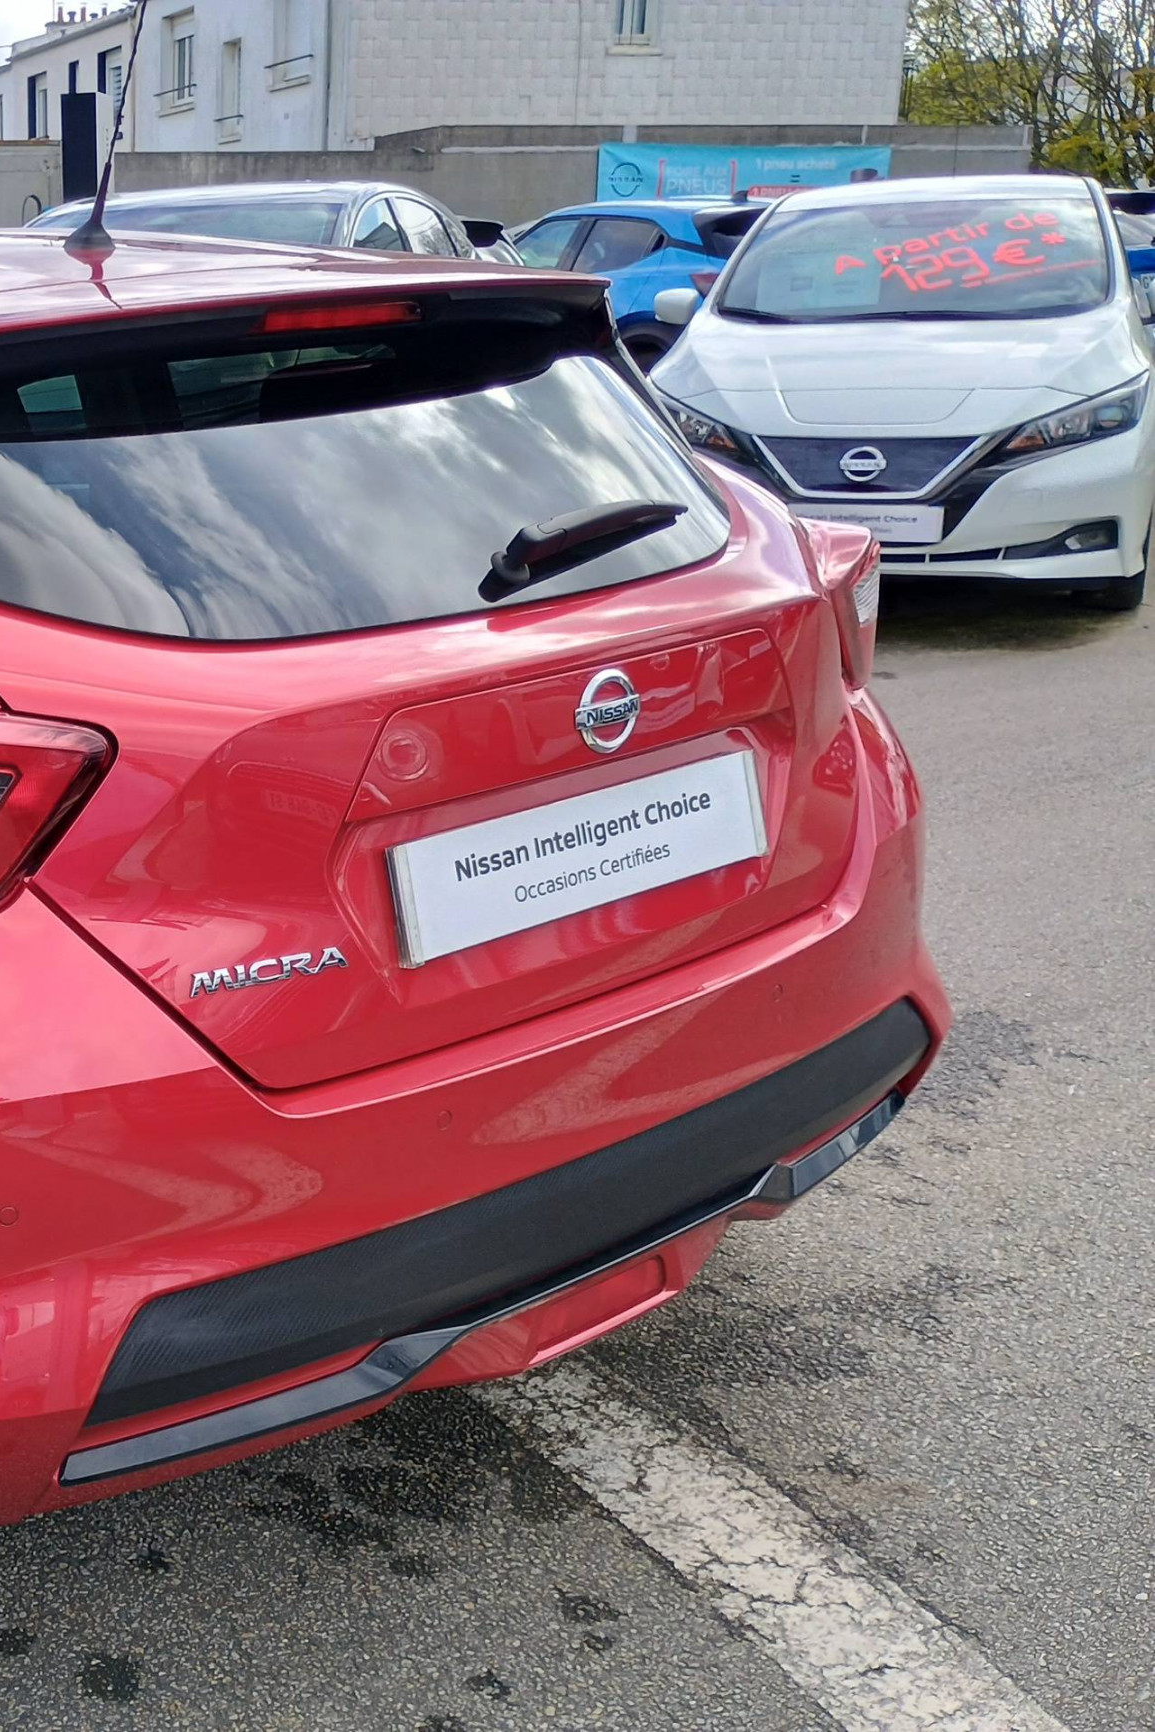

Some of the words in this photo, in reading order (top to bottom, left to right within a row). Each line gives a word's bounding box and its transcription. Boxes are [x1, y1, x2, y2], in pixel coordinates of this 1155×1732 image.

[764, 160, 795, 172] pneu
[666, 178, 726, 194] PNEUS
[1004, 211, 1060, 231] de
[881, 246, 990, 292] 129
[883, 514, 918, 523] Choice
[586, 698, 639, 724] NISSAN
[454, 844, 530, 882] Nissan
[533, 809, 642, 859] Intelligent
[644, 792, 712, 826] Choice
[514, 866, 597, 902] Occasions
[599, 844, 671, 876] Certifiées
[190, 946, 349, 998] MICRA
